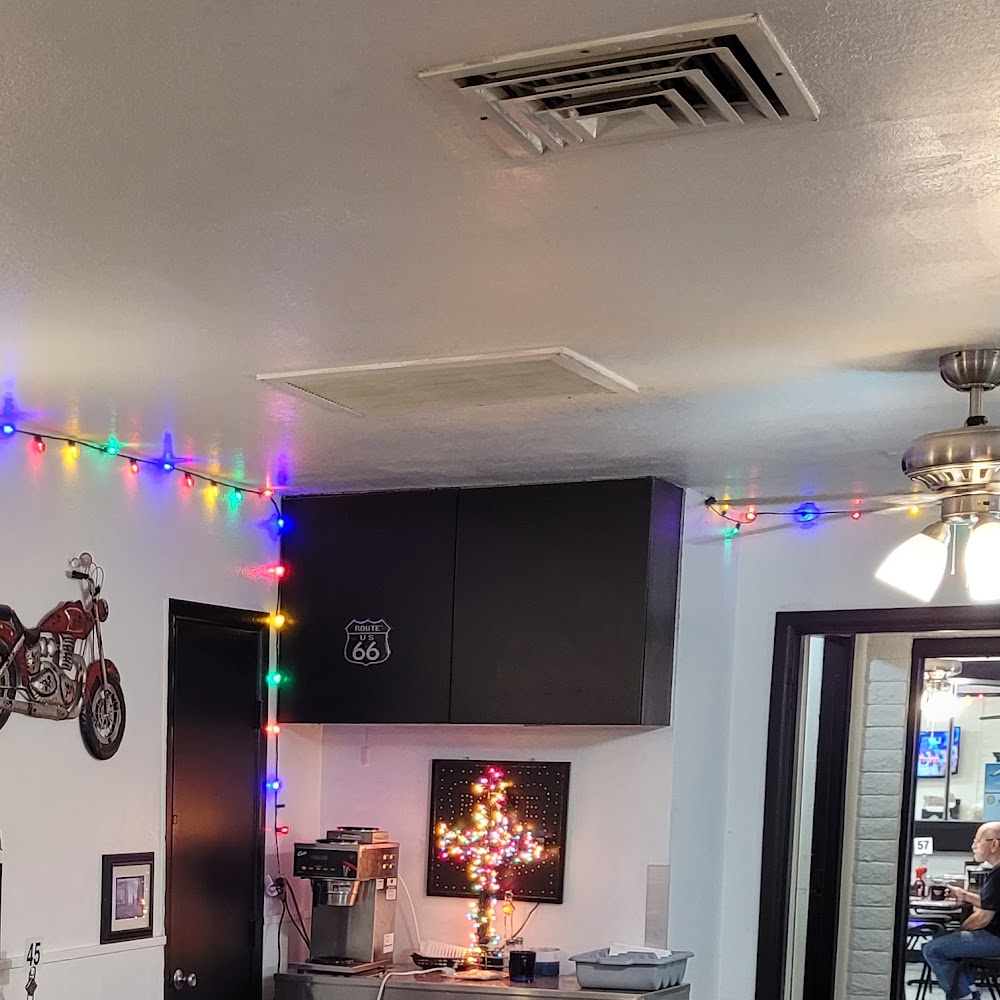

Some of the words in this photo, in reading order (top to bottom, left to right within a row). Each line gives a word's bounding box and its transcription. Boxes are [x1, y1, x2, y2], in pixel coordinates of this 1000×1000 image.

[352, 641, 380, 661] 66
[917, 840, 930, 851] 57
[26, 942, 41, 966] 45
